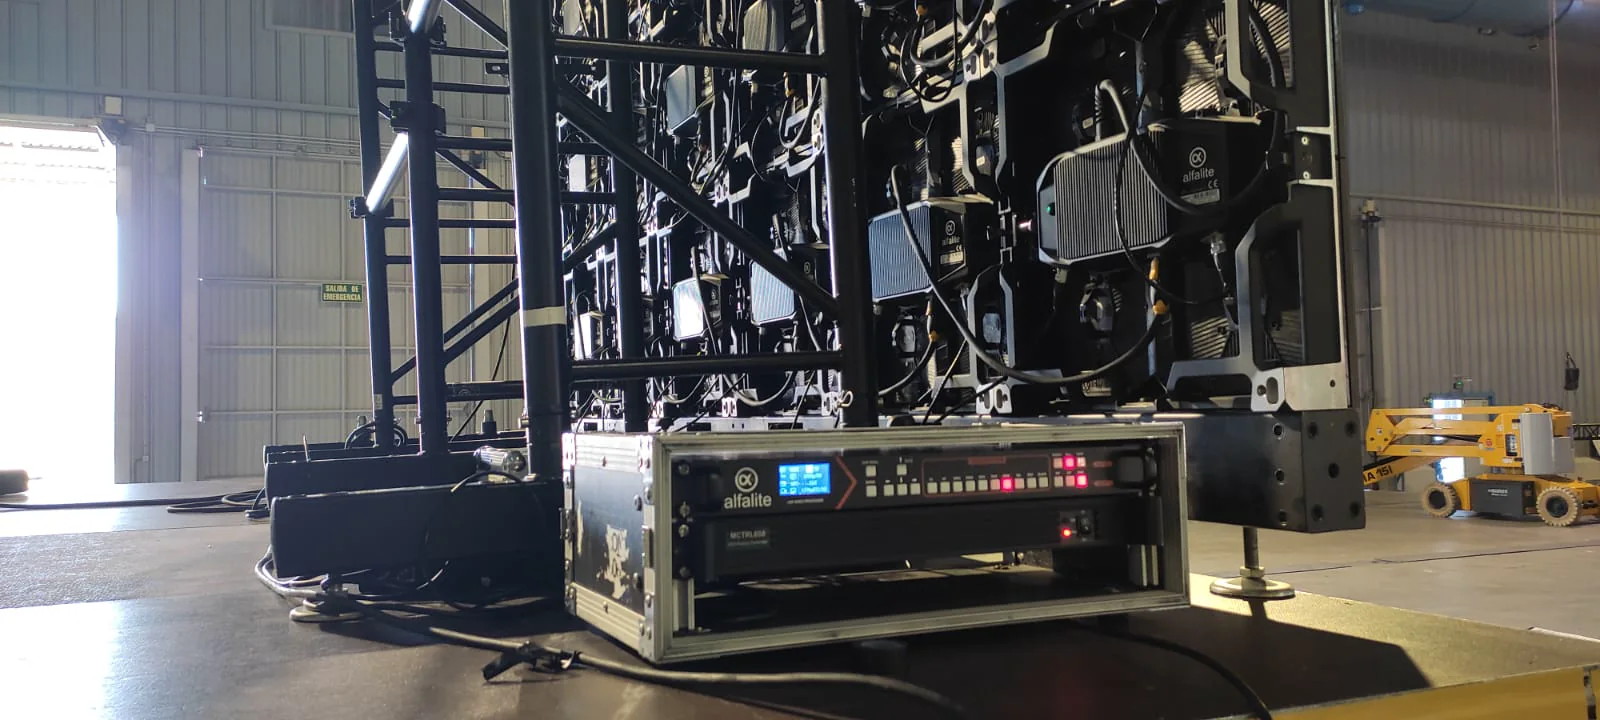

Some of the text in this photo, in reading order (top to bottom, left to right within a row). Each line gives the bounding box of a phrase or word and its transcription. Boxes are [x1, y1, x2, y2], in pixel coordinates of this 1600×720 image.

[1182, 167, 1215, 183] alfalite
[325, 284, 359, 293] SALIDA DE
[323, 293, 361, 301] EMERGENCIA
[723, 492, 772, 509] alfalite
